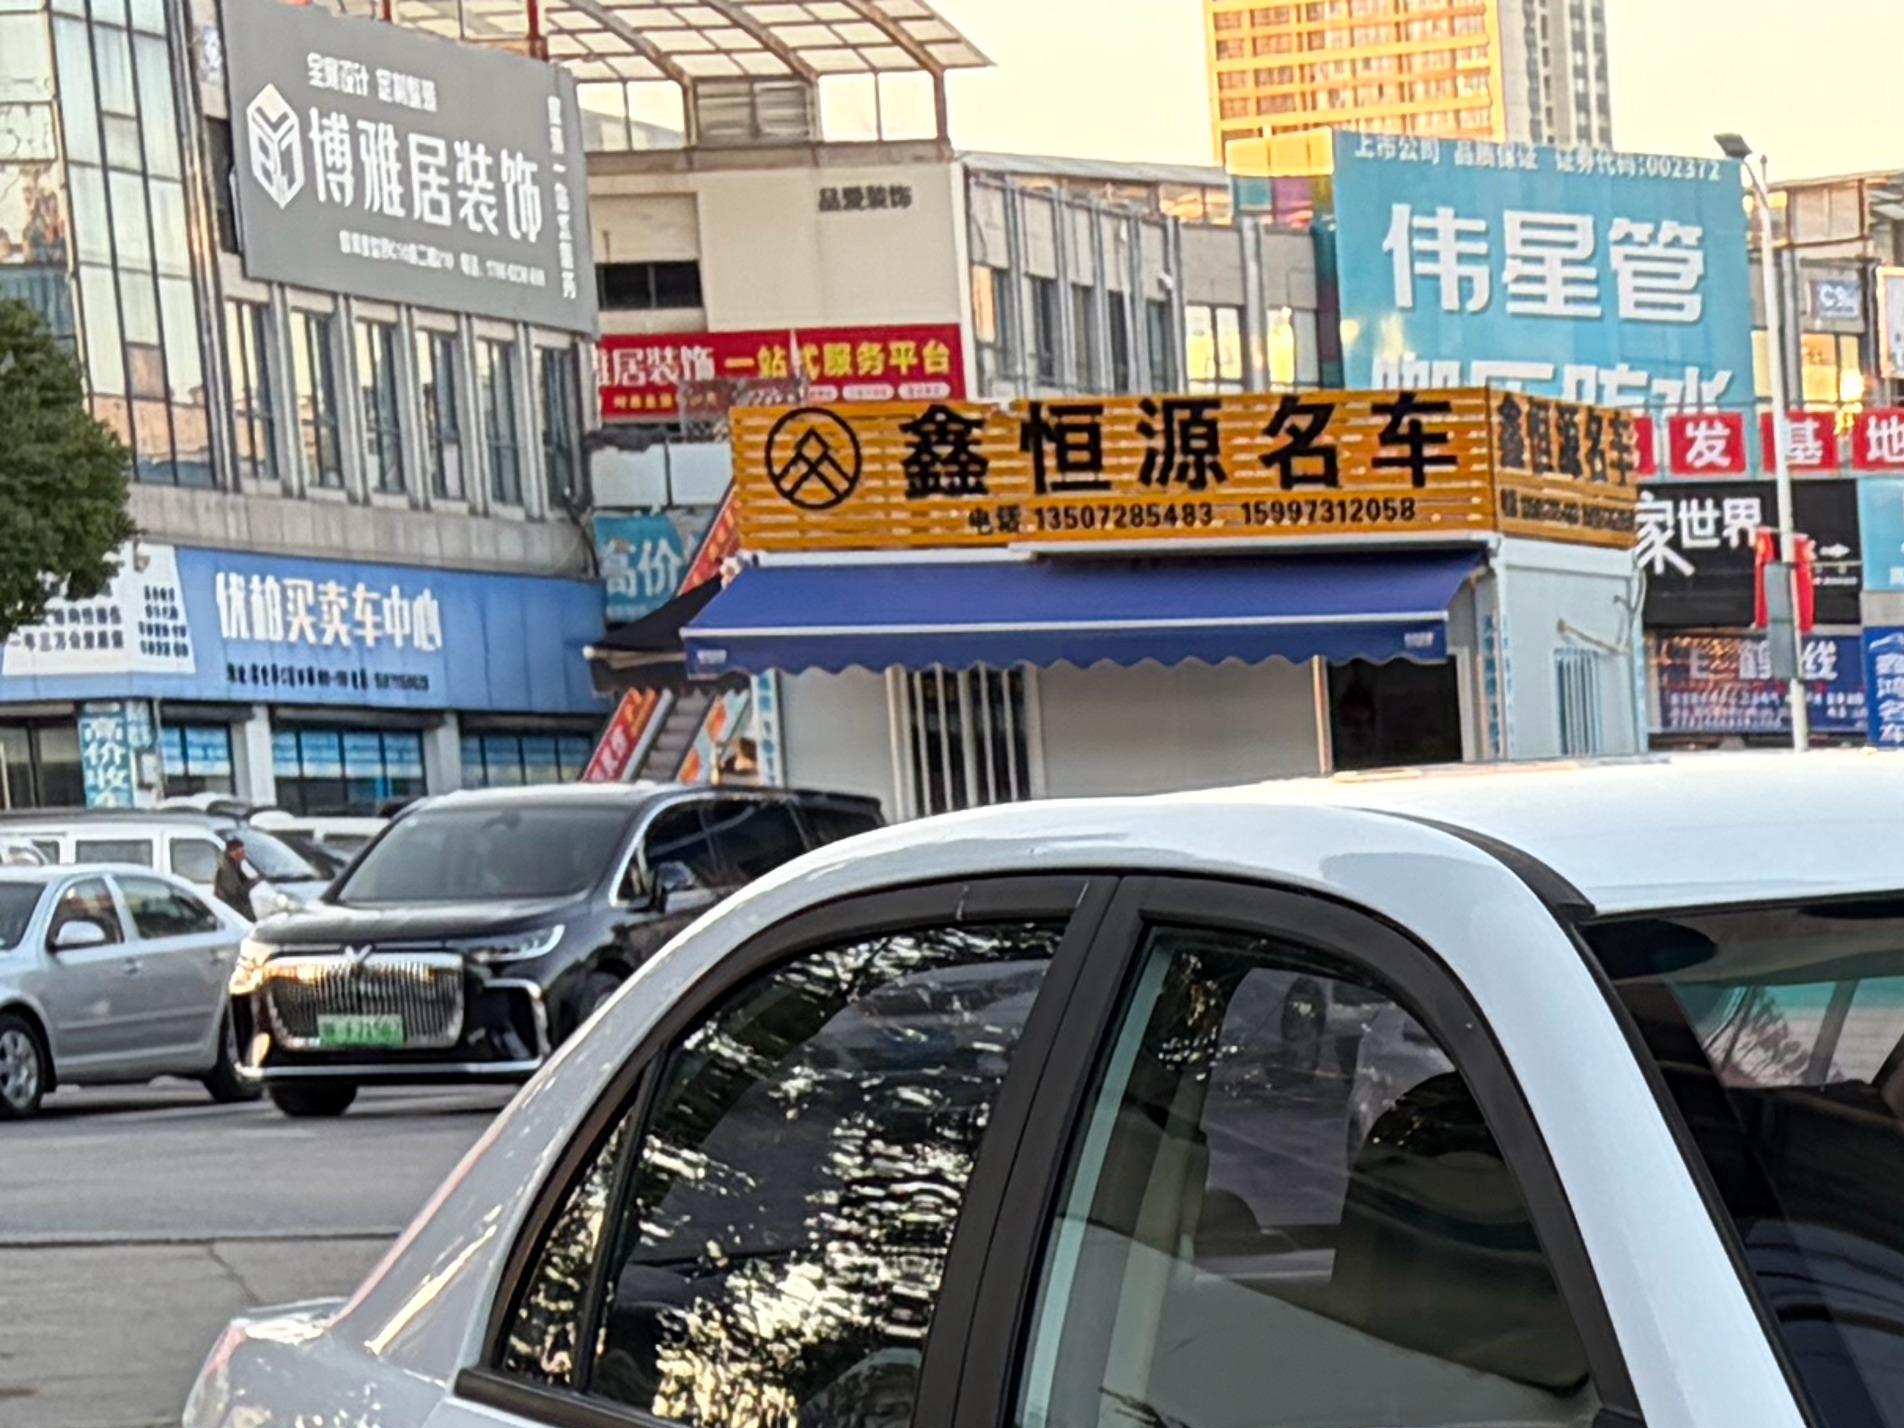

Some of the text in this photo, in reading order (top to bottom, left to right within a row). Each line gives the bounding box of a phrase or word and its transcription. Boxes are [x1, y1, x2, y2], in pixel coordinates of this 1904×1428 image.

[308, 107, 542, 243] 博雅居装饰
[1353, 136, 1440, 165] 上市公司
[1382, 203, 1704, 322] 伟星管
[725, 341, 950, 380] 一站式服务平台
[900, 393, 1457, 498] 鑫恒源名车
[968, 498, 1416, 536] 电话 13507285483 15997312058
[1634, 490, 1761, 577] 家世界
